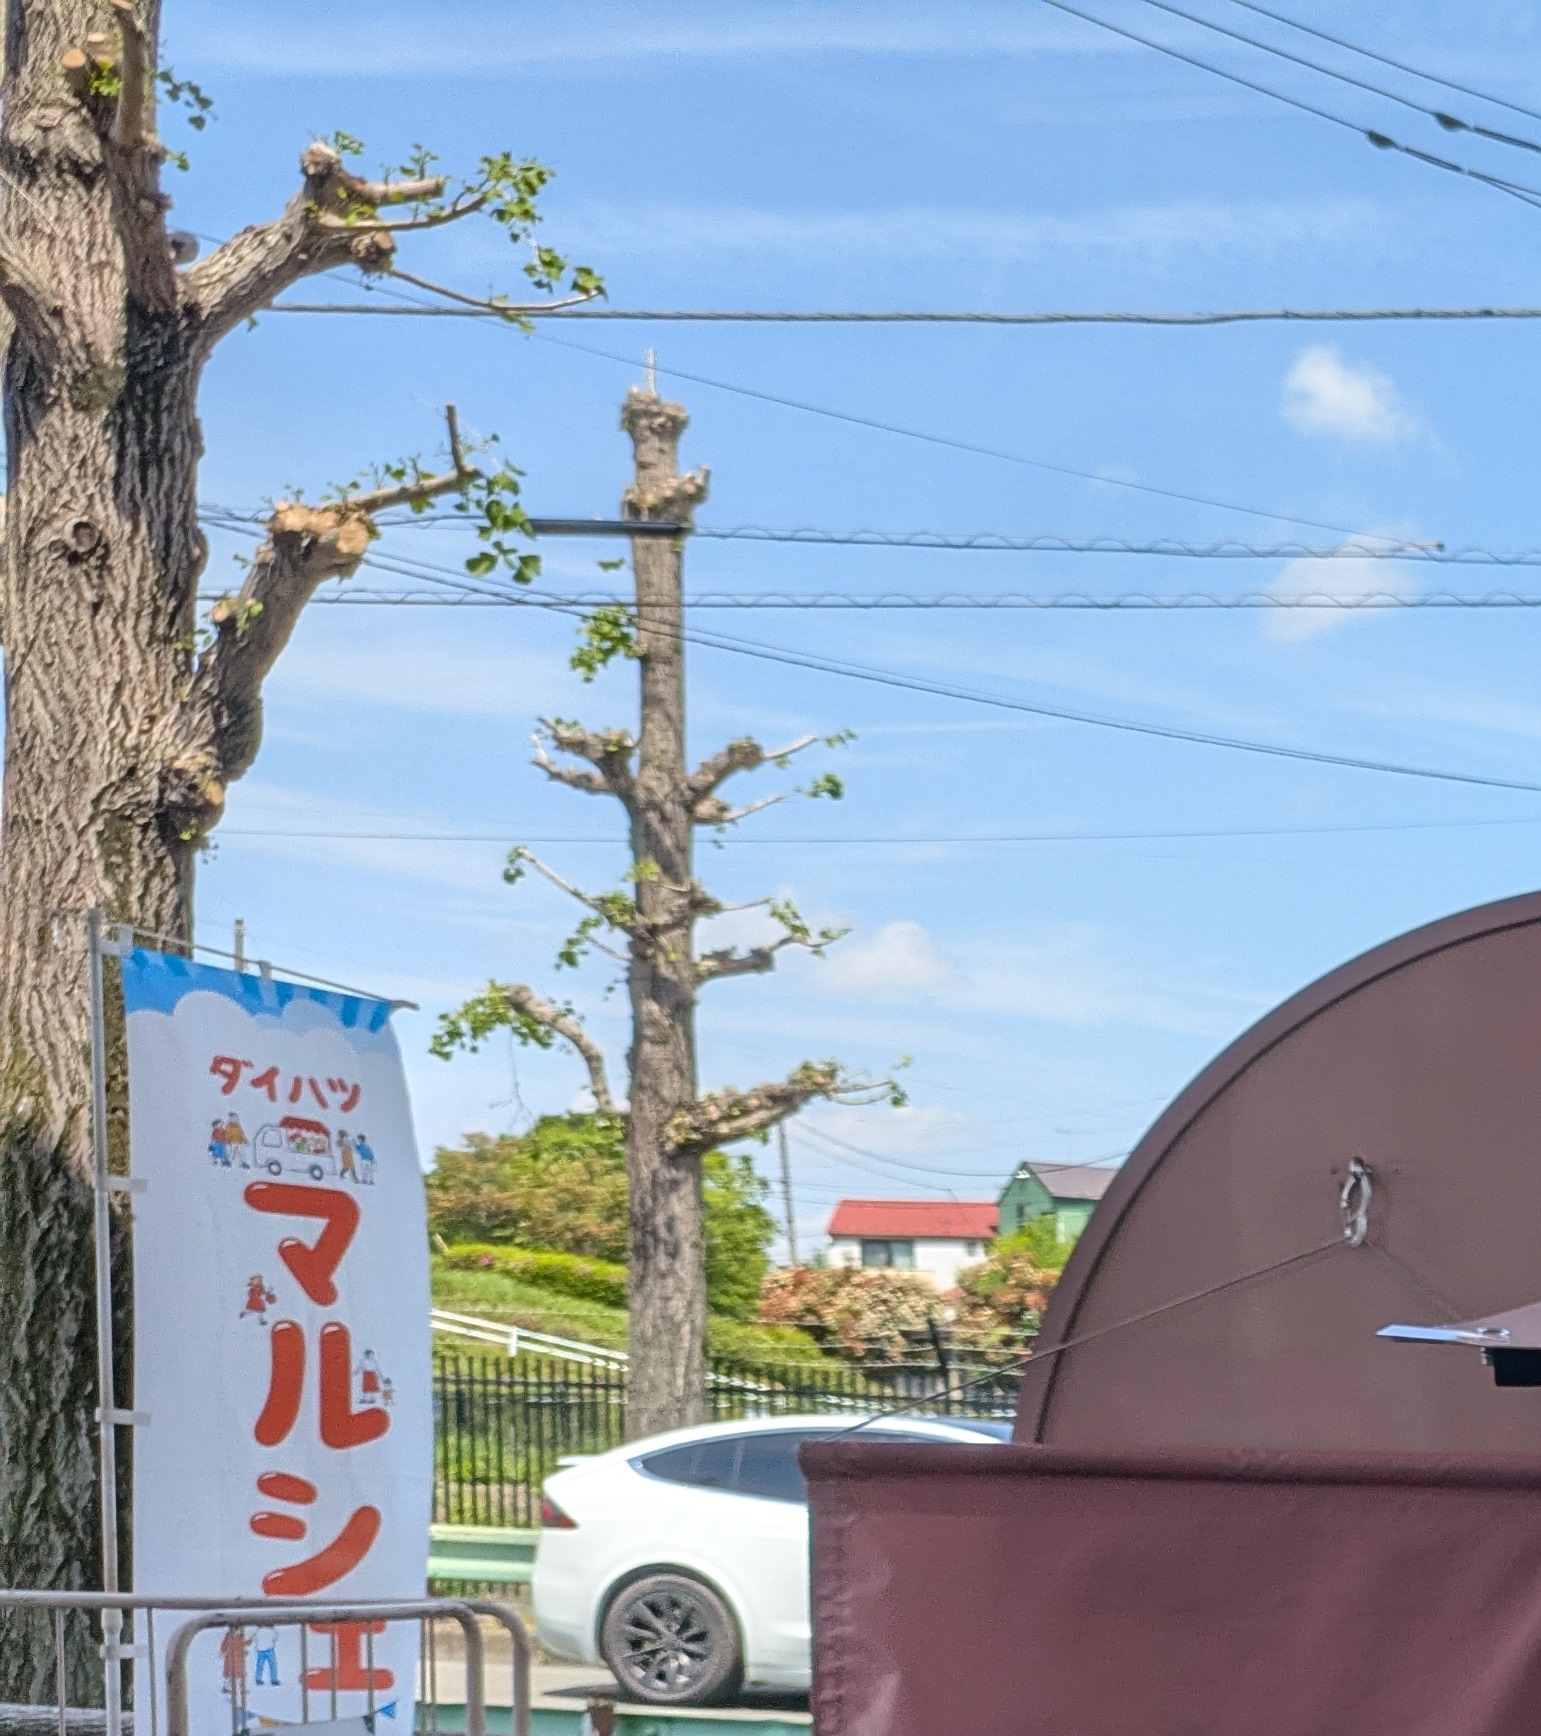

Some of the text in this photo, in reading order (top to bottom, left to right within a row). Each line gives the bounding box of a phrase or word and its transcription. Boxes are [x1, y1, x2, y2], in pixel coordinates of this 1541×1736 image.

[210, 1055, 361, 1112] ダイハツ
[244, 1181, 393, 1691] マルシェ
